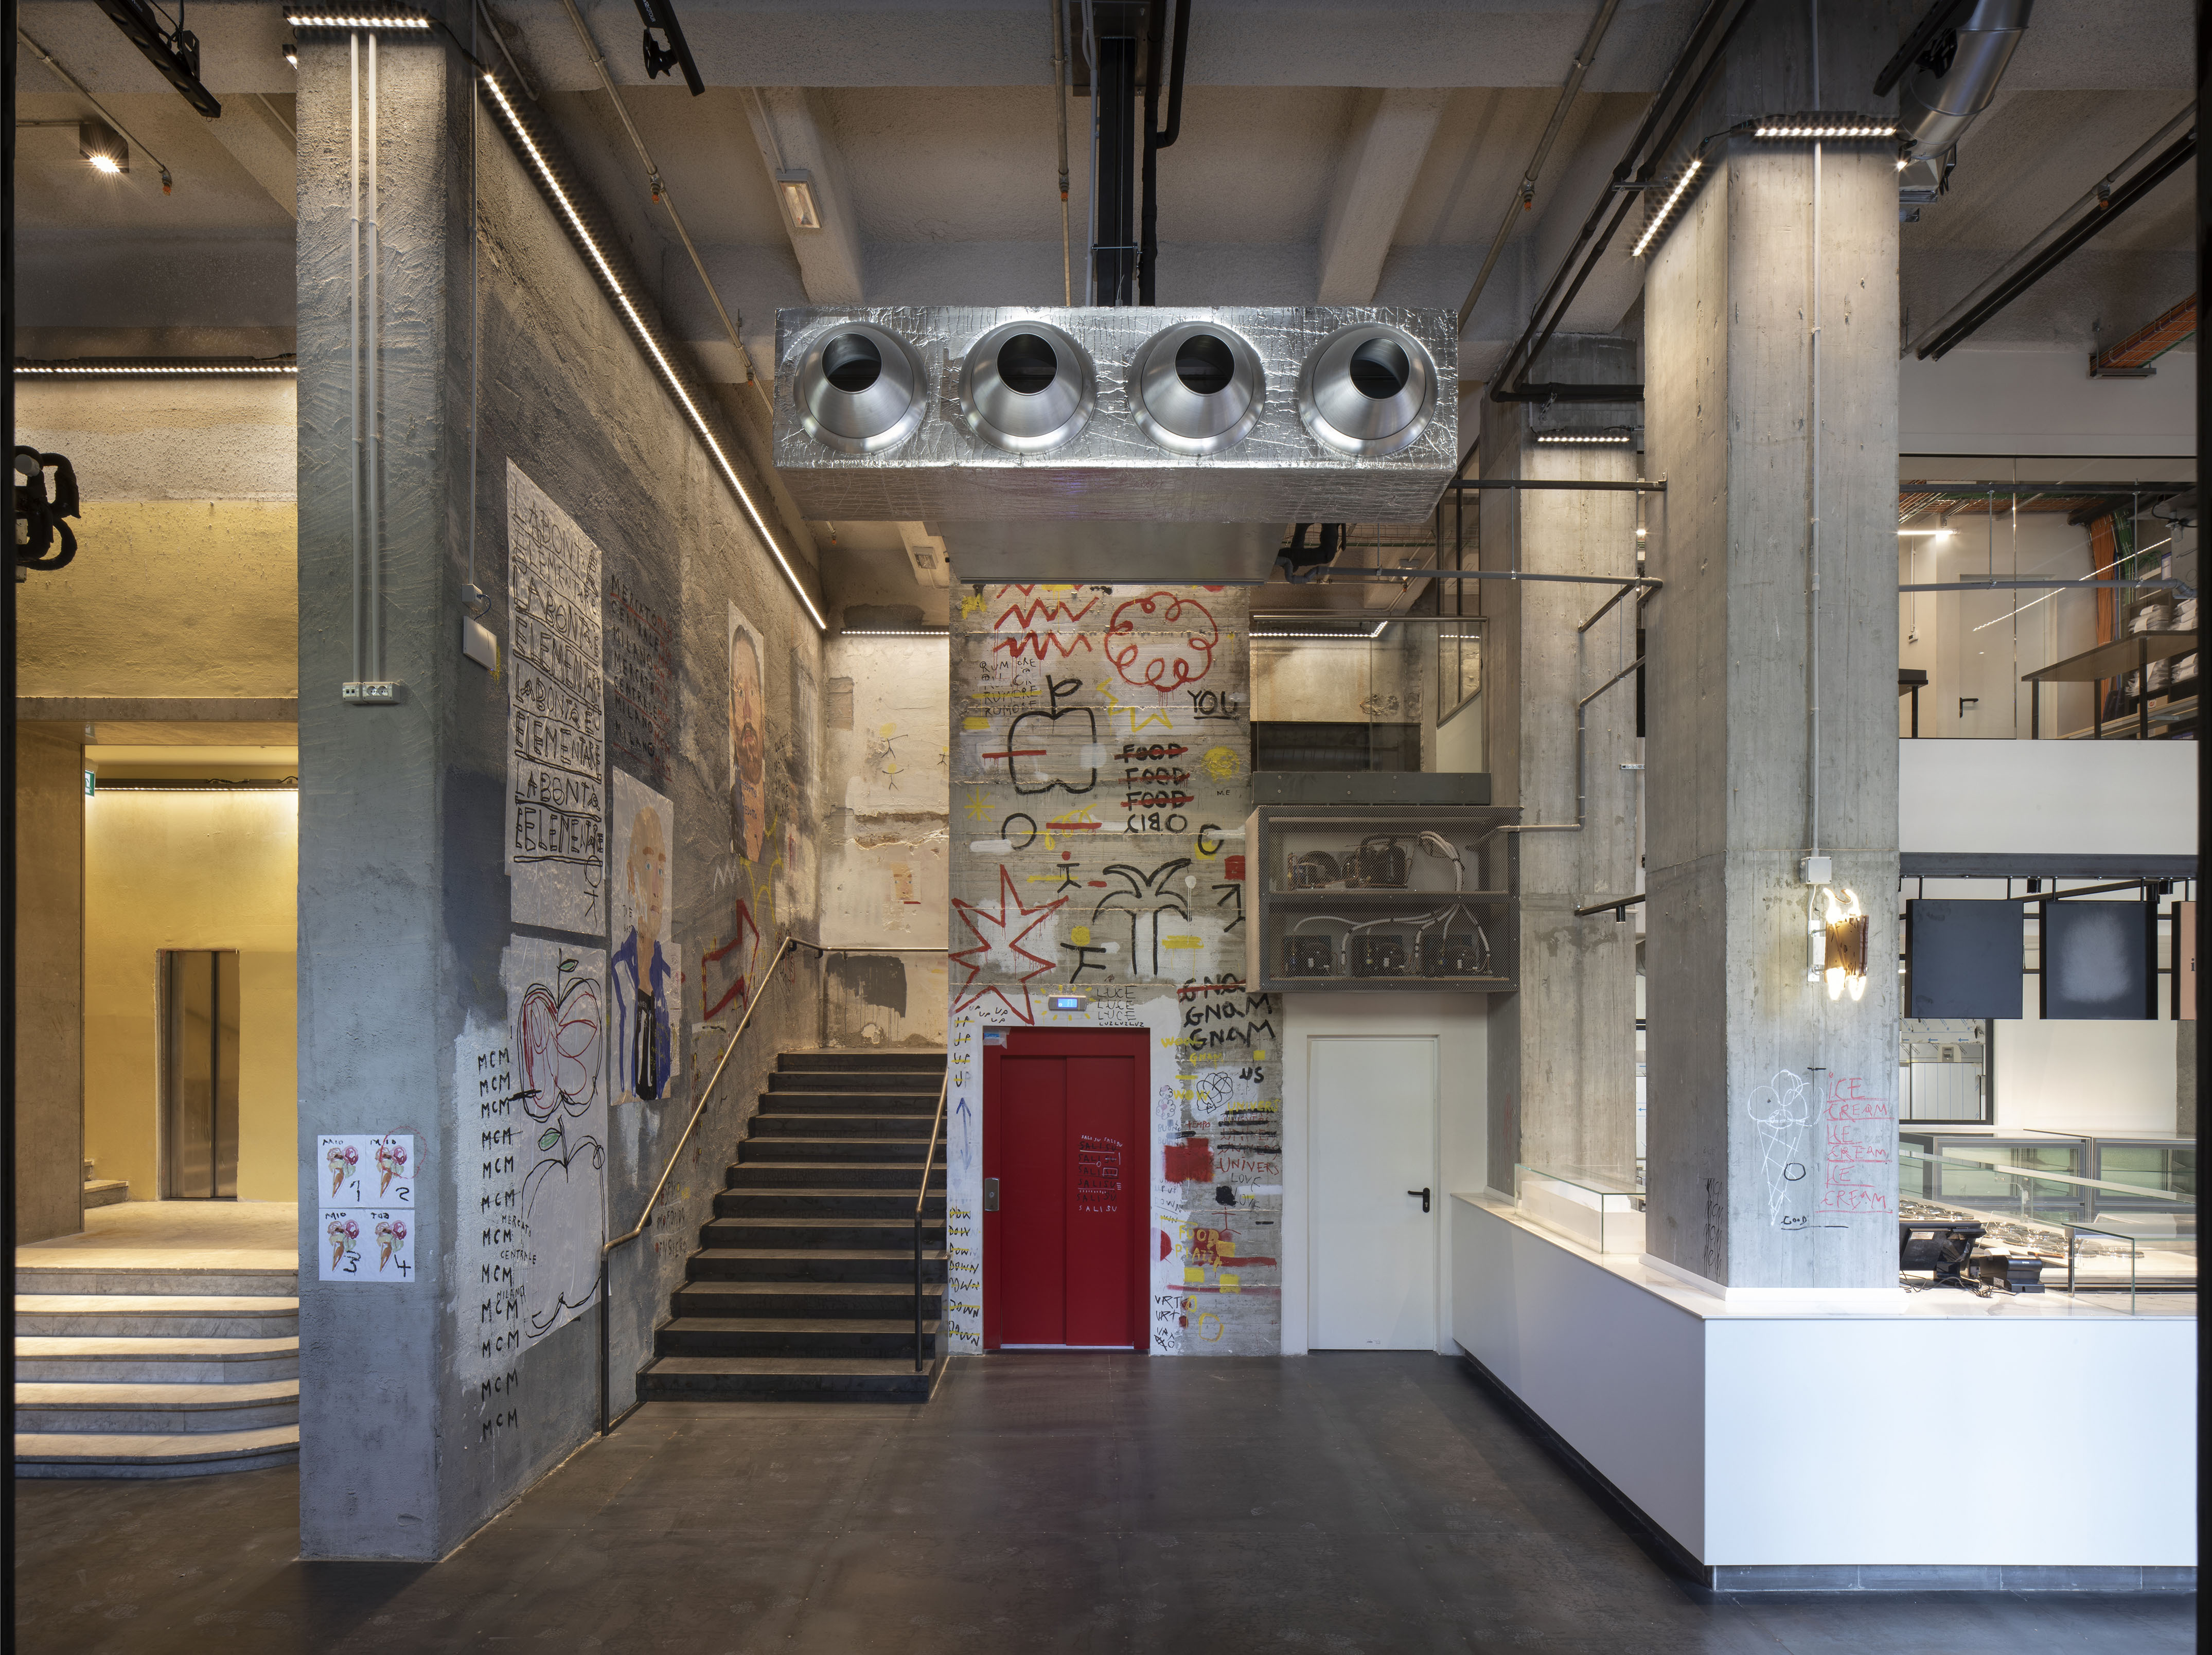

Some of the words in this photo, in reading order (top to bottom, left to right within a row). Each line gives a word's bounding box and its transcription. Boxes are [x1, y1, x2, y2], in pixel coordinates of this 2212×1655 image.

[1188, 690, 1237, 715] YOU
[1123, 743, 1184, 763] FOOD
[1125, 767, 1185, 790] FOOD
[1126, 791, 1187, 811] FOOD
[1097, 986, 1137, 999] LUCE
[1098, 999, 1135, 1010] LUCE
[1184, 993, 1272, 1027] GNAM
[1098, 1011, 1137, 1021] LUCE
[1190, 1019, 1277, 1051] GNAM
[478, 1047, 510, 1074] MCM
[479, 1072, 510, 1097] MCM
[1240, 1067, 1264, 1083] US
[1173, 1090, 1210, 1101] WOW
[1829, 1077, 1865, 1102] ICE
[481, 1097, 510, 1119] MCM
[1824, 1103, 1887, 1123] CREAM
[482, 1127, 511, 1151] MCM
[1827, 1146, 1887, 1161] CREAM
[483, 1155, 514, 1179] MCM
[395, 1187, 410, 1201] 2
[481, 1188, 515, 1214] MCM
[1820, 1190, 1886, 1209] CREAM
[502, 1214, 532, 1237] MERCATO
[482, 1227, 511, 1247] MCM
[394, 1254, 411, 1277] 4
[500, 1249, 537, 1265] CENTRALE
[949, 1260, 979, 1274] DOWN
[482, 1264, 512, 1287] MCM
[497, 1286, 525, 1302] MILANO
[482, 1298, 518, 1323] MCM
[949, 1298, 979, 1318] DOWN
[483, 1329, 519, 1358] MCM
[481, 1368, 519, 1402] MCM
[483, 1408, 518, 1440] MCM
